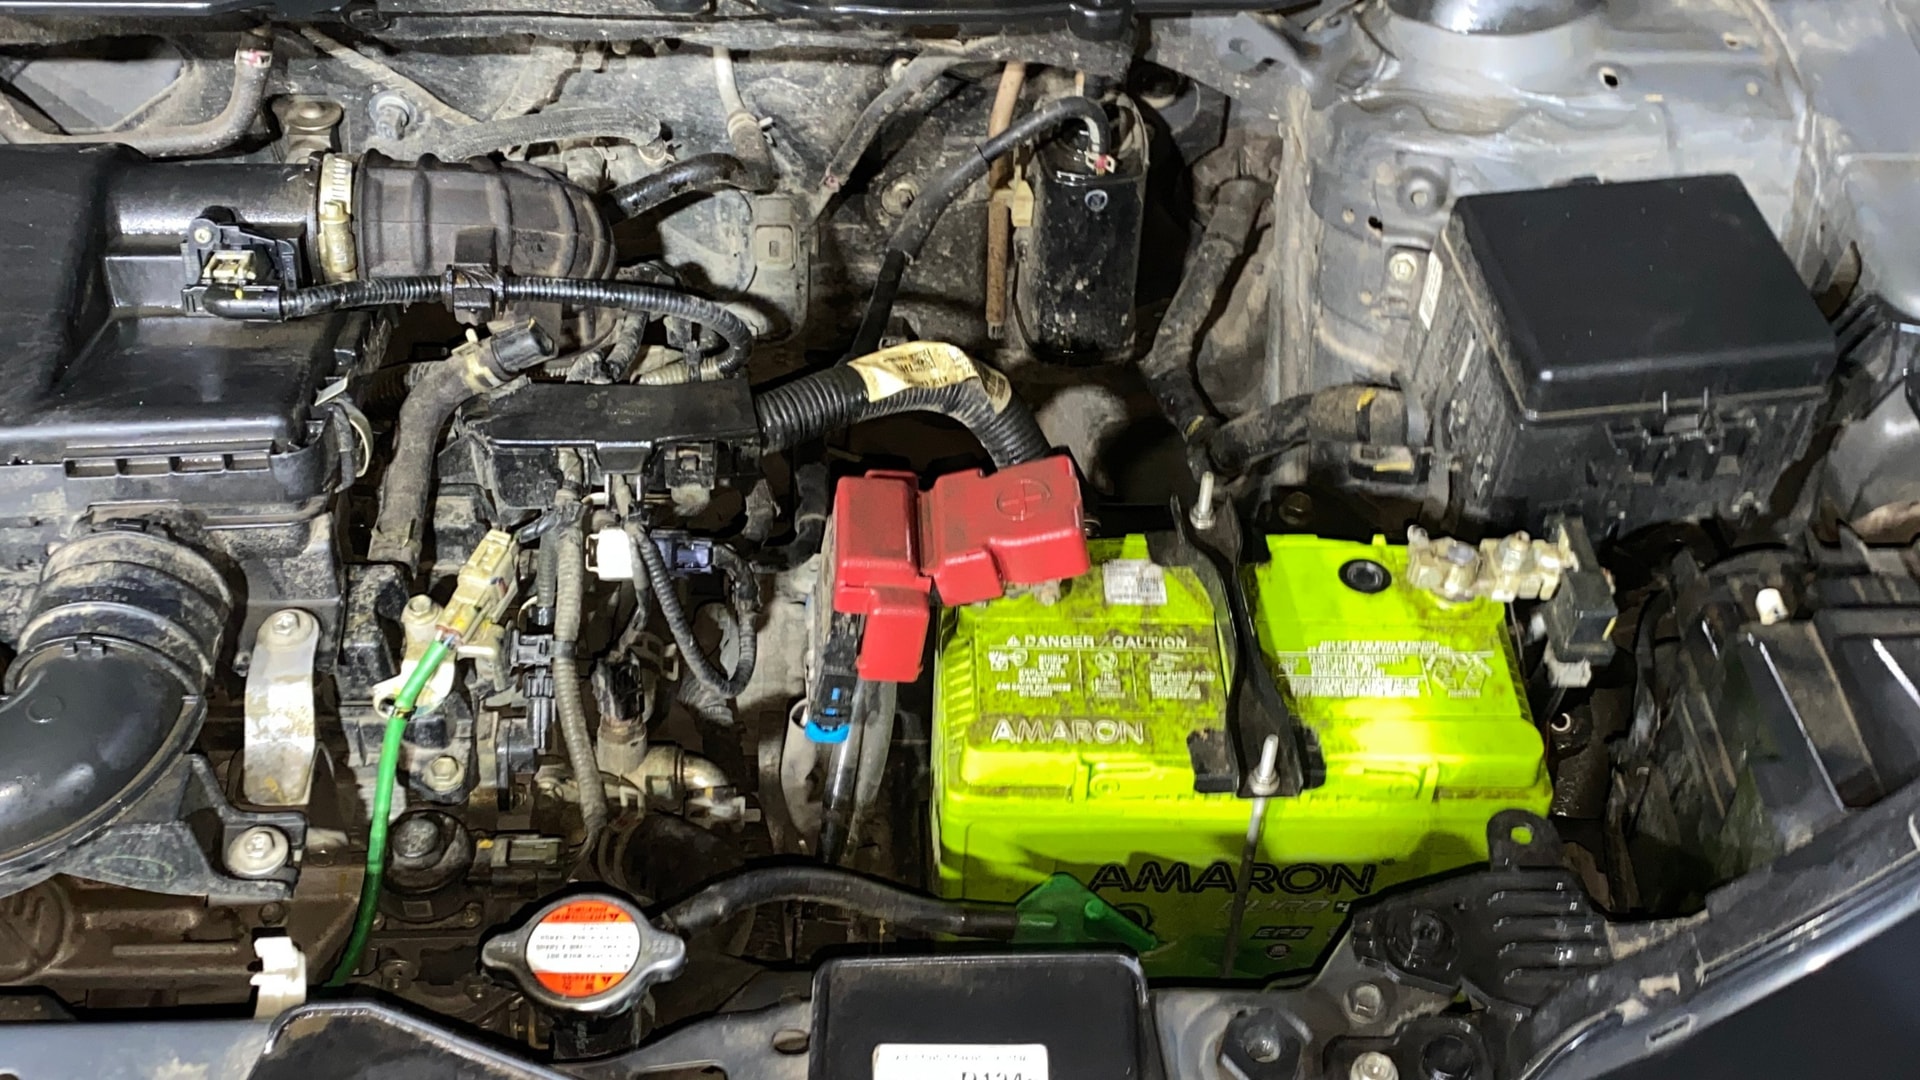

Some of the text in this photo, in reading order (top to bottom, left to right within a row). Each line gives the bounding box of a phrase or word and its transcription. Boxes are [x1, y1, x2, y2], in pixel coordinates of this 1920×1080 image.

[1025, 635, 1094, 648] DANGER
[1112, 636, 1187, 649] CAUTION
[991, 719, 1143, 744] AMARON
[1089, 862, 1377, 895] AMARON
